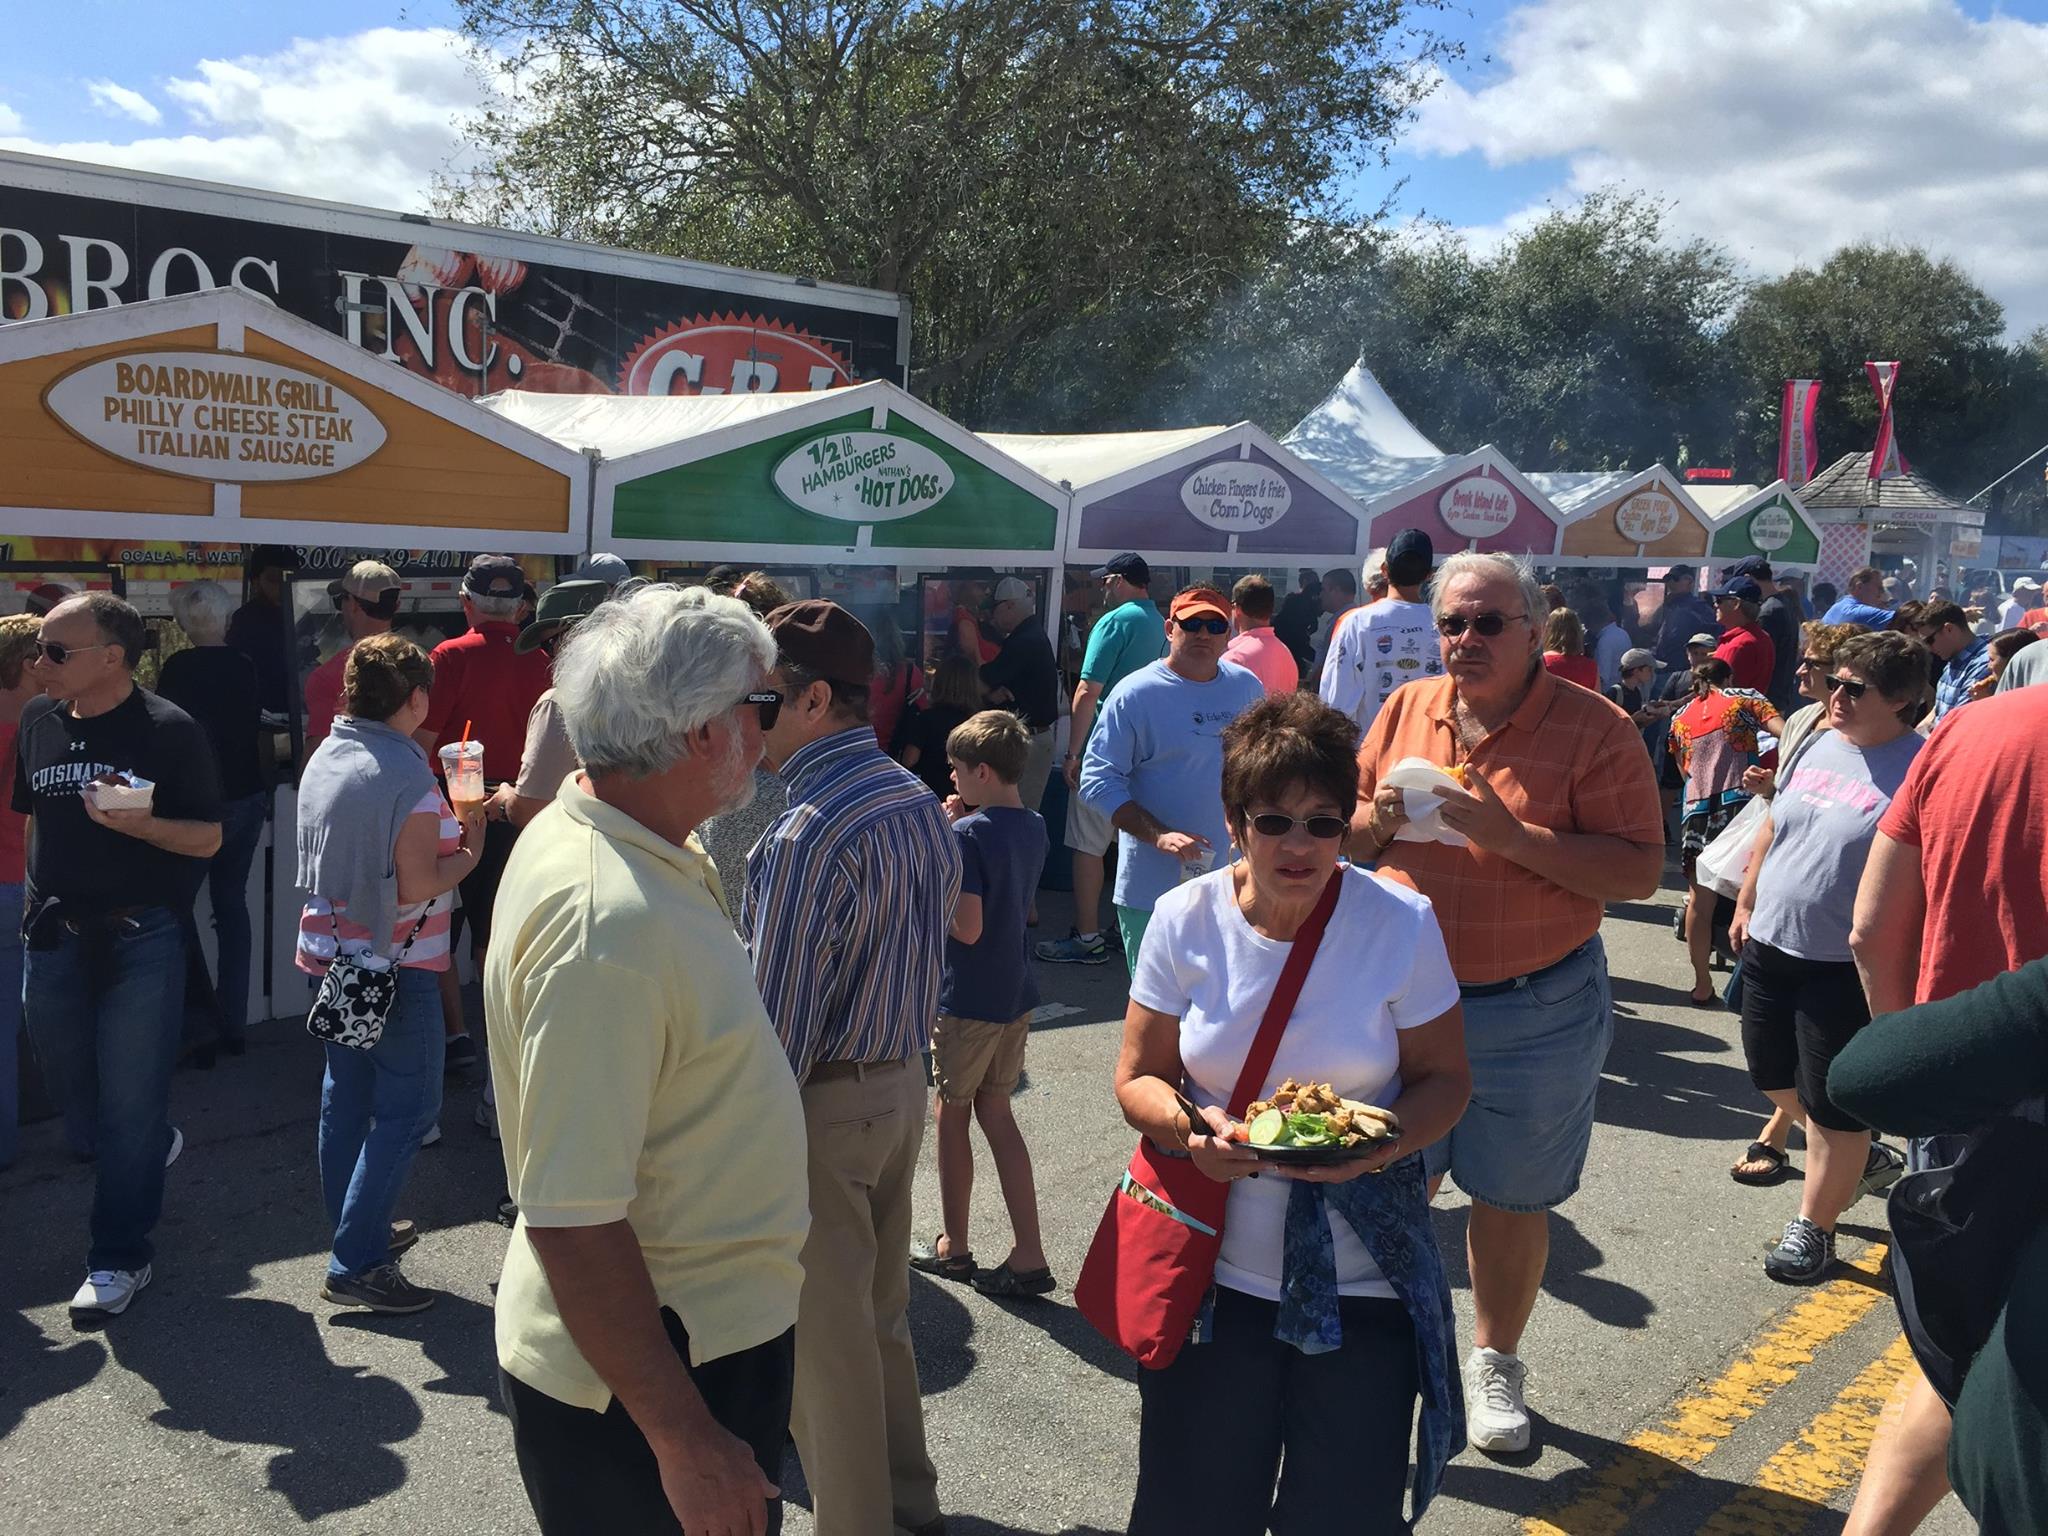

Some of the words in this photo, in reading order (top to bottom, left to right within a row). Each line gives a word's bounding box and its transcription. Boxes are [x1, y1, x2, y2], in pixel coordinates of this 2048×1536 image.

[337, 270, 522, 375] INC.
[116, 362, 273, 406] BOARDWALK
[275, 378, 340, 413] GRILL
[103, 396, 185, 428] PHILLY
[193, 404, 280, 436] CHEESE
[285, 412, 354, 443] STEAK
[137, 429, 230, 460] ITALIAN
[238, 438, 335, 467] SAUSAGE
[807, 436, 841, 469] 1/2
[841, 435, 857, 457] LB.
[801, 442, 896, 495] HAMBURGERS
[860, 476, 895, 508] HOT
[898, 473, 939, 506] DOGS
[1192, 475, 1227, 496] Chicken
[1228, 478, 1258, 503] Fingers
[1259, 479, 1266, 498] &
[1210, 499, 1239, 518] Corn
[1242, 500, 1274, 524] Dogs
[1891, 511, 1904, 520] ICE
[1907, 511, 1937, 520] CREAM
[121, 551, 173, 563] OCALA
[187, 551, 202, 563] FL
[749, 694, 776, 702] GEICO
[32, 762, 115, 791] CUISINART
